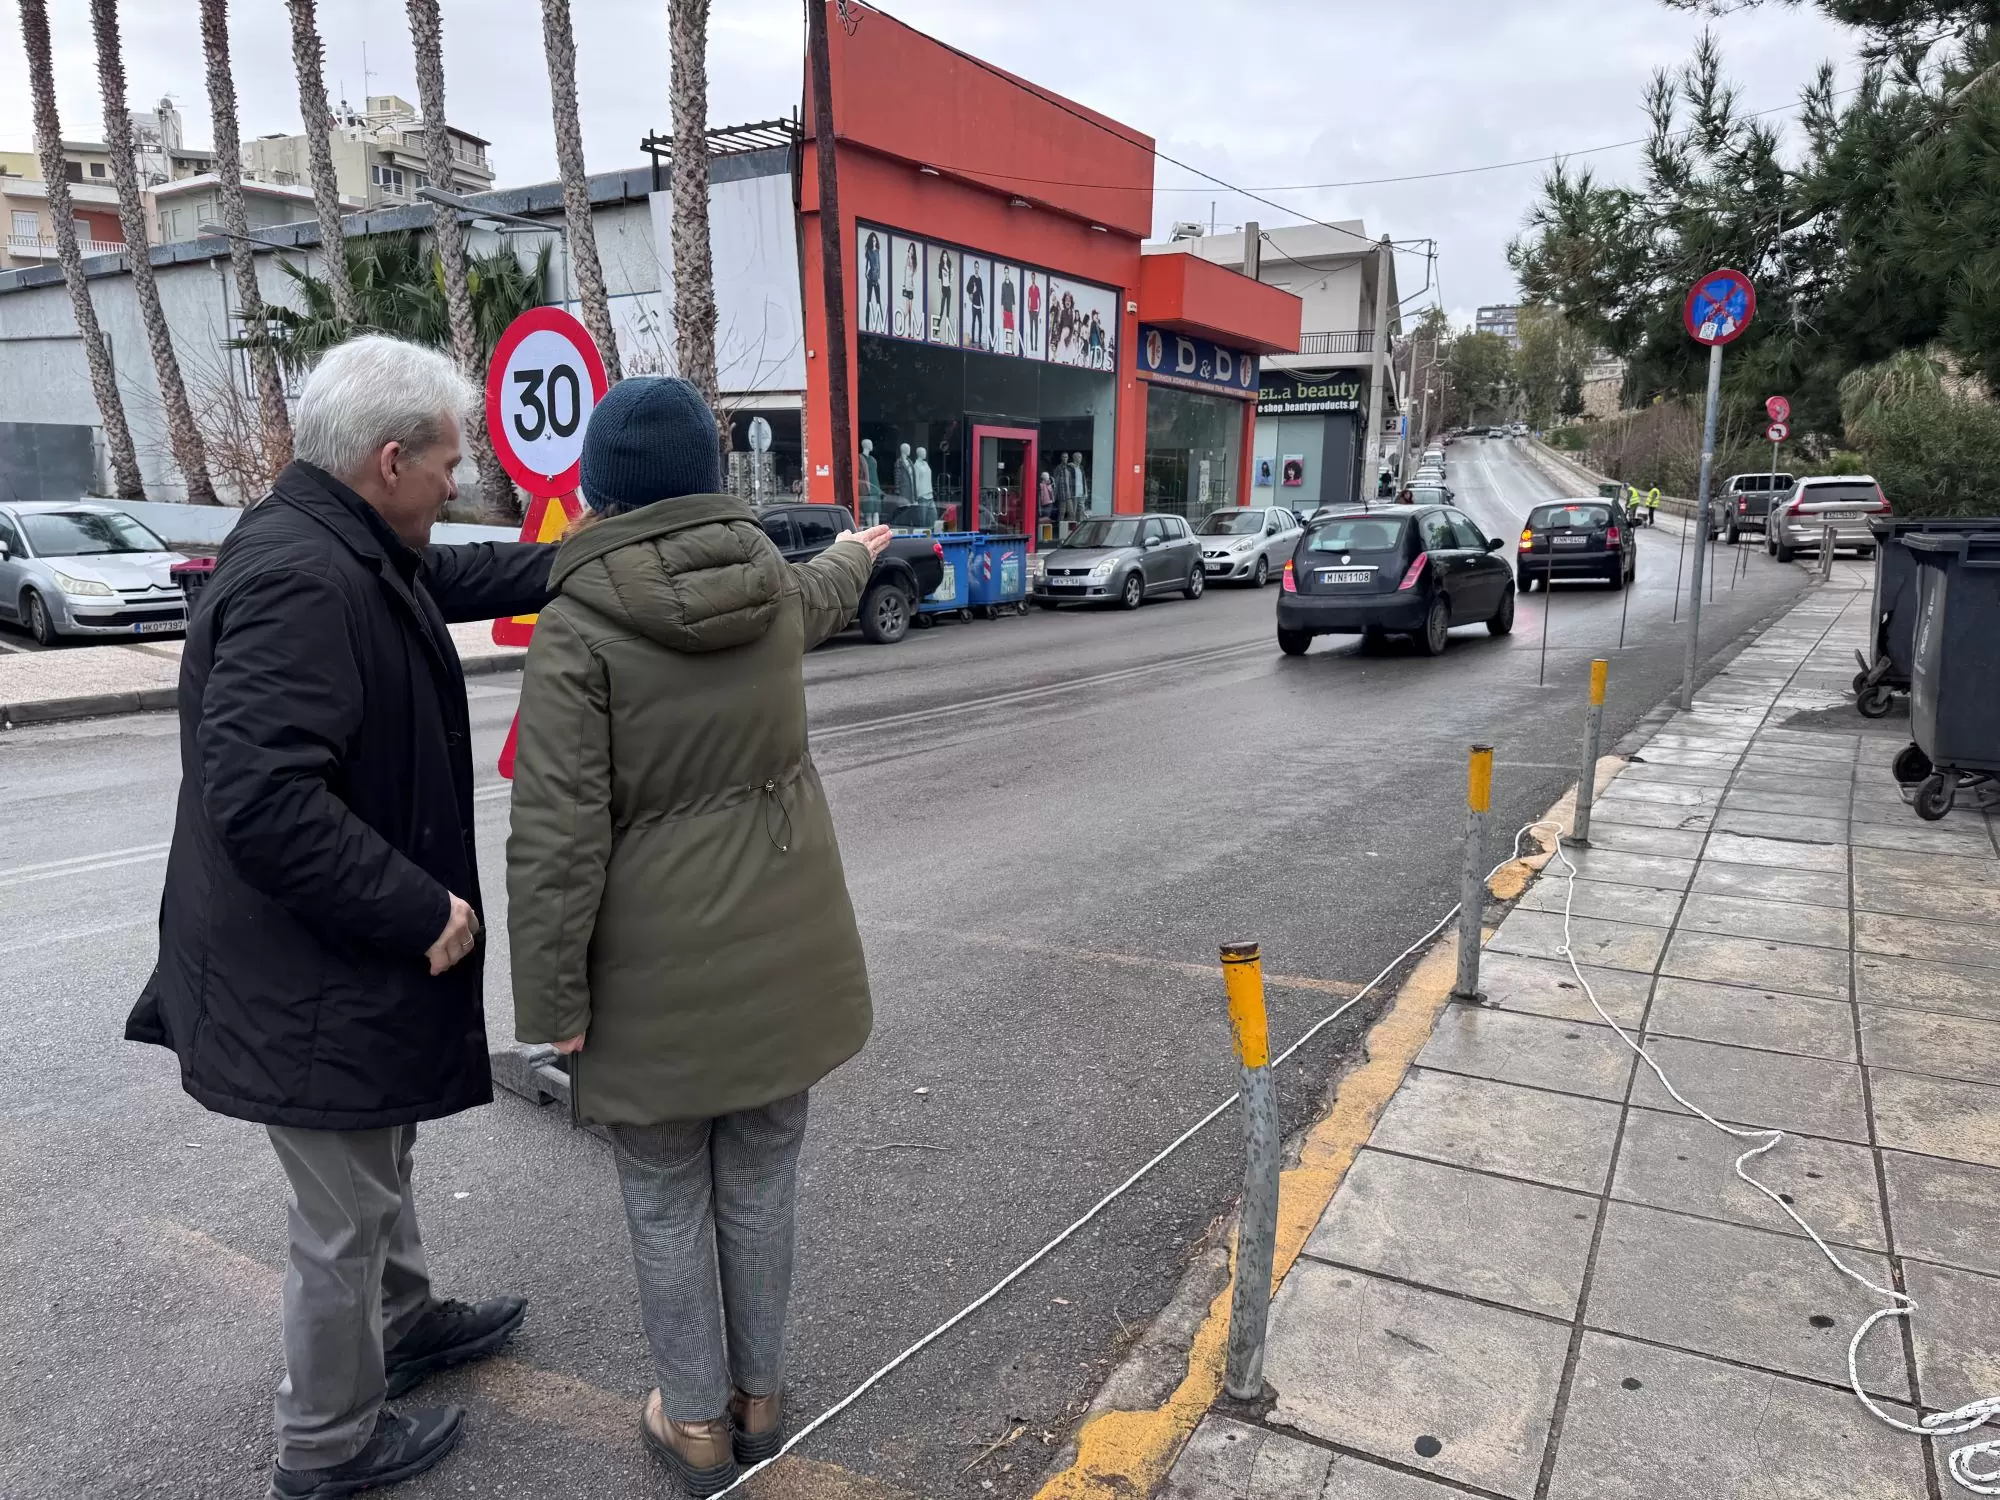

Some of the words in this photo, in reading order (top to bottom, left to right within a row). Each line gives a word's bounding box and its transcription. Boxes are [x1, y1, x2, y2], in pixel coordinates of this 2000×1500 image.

[869, 302, 957, 346] WOMEN
[986, 328, 1027, 358] MEN
[1074, 342, 1114, 371] KIDS
[513, 364, 580, 442] 30
[1297, 382, 1360, 399] beauty
